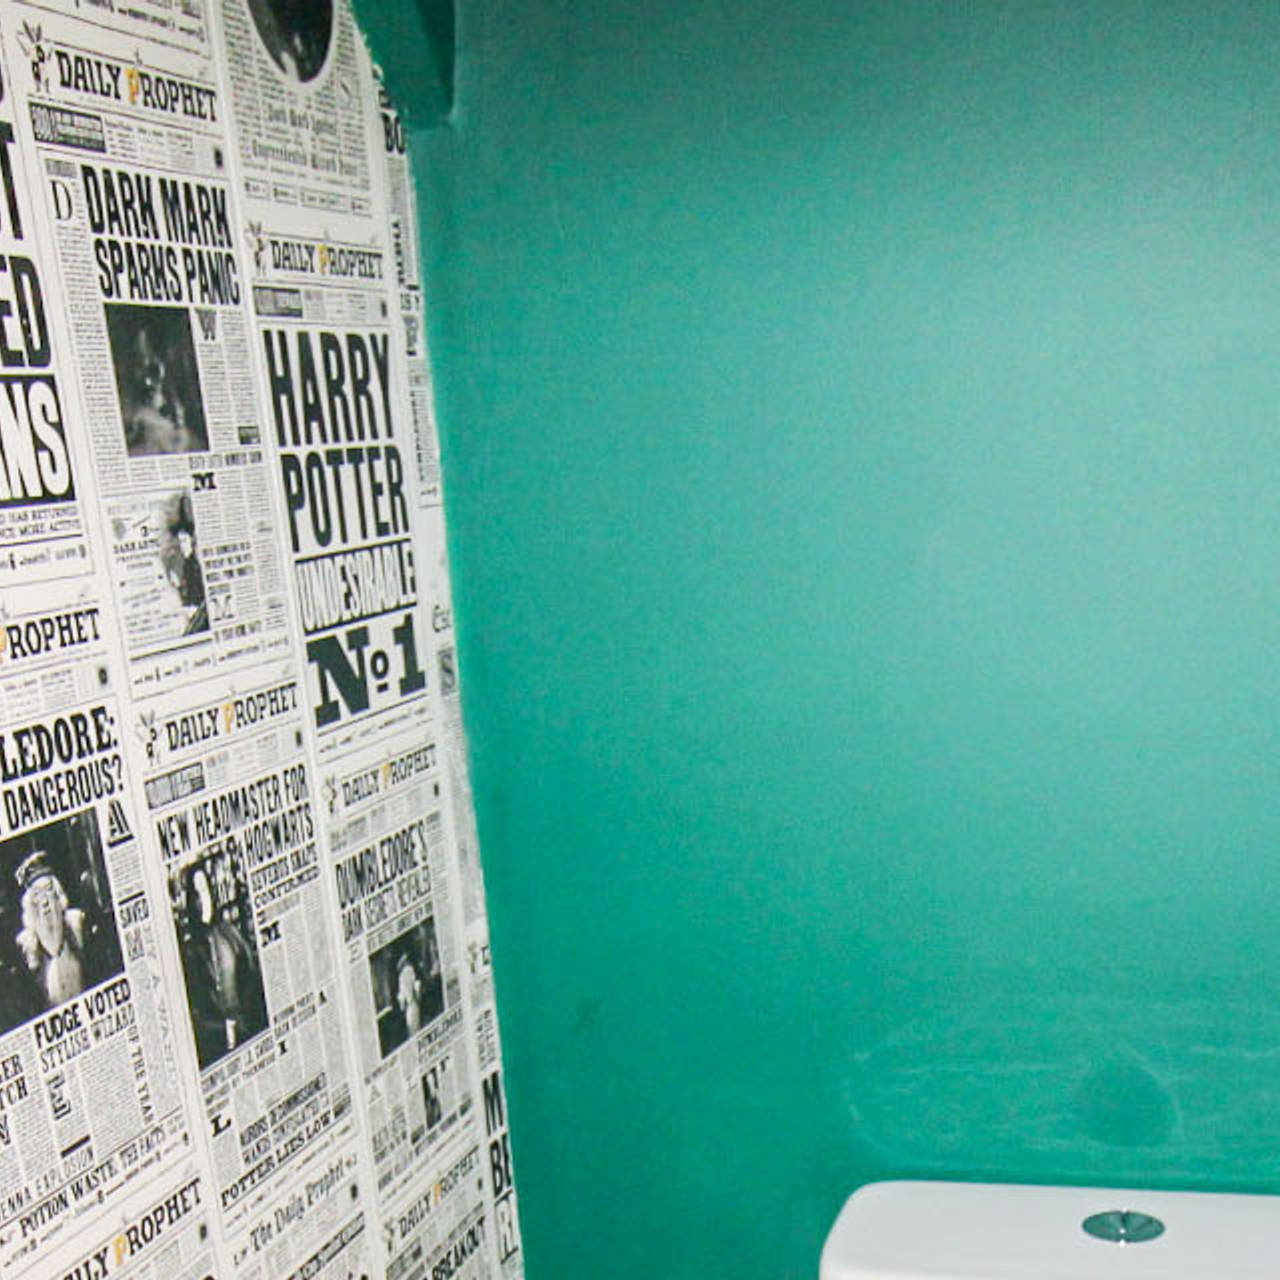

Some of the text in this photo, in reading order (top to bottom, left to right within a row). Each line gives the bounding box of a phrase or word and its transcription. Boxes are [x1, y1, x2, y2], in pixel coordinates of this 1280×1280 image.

[53, 49, 218, 123] DAILY PROPHET
[80, 163, 234, 249] DARK MARK
[94, 238, 240, 306] SPARKS PANIC
[263, 329, 394, 448] HARRY
[280, 445, 410, 554] POTTER
[166, 681, 299, 753] DAILY PROPHET
[2, 753, 124, 831] DANGEROUS?
[156, 763, 310, 862] NEW HEADMASTER FOR
[243, 802, 316, 868] HOGWARTS
[33, 977, 132, 1050] FUDGE VOTED
[19, 1197, 71, 1239] POTION
[112, 1177, 203, 1268] PROPHET
